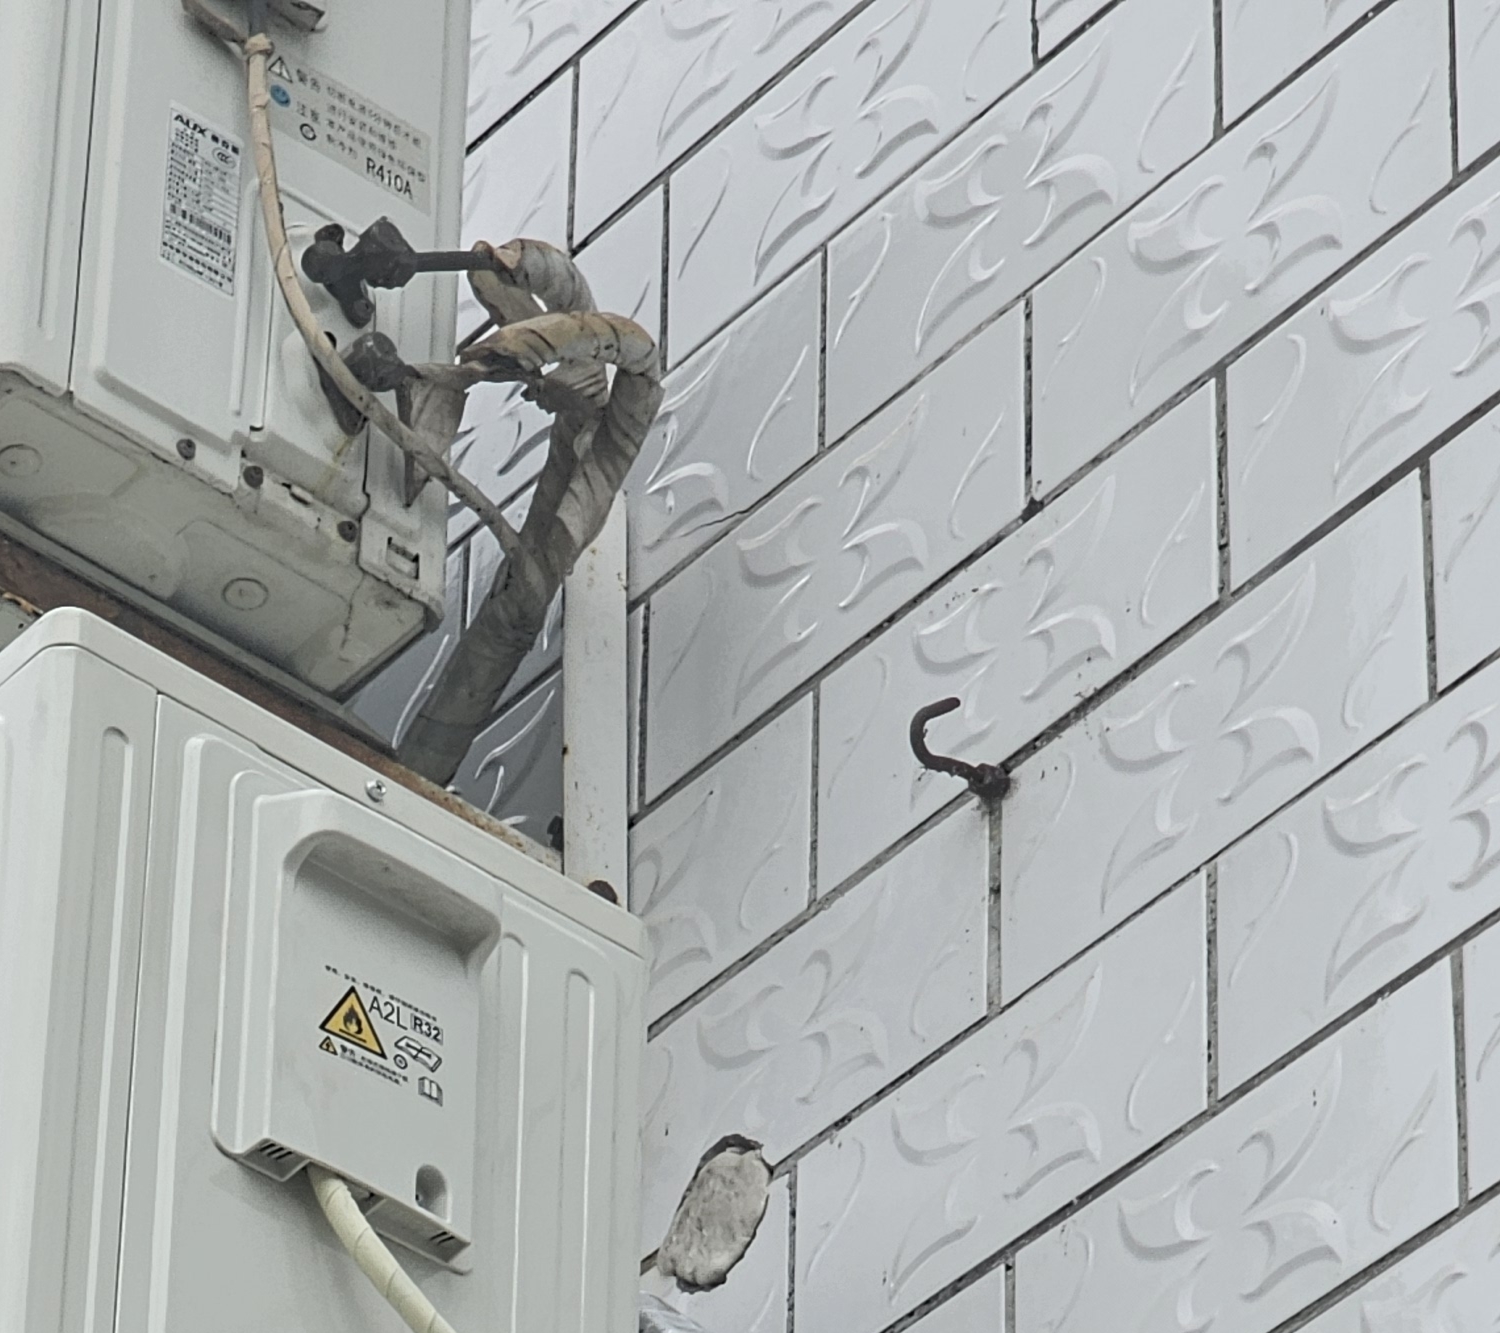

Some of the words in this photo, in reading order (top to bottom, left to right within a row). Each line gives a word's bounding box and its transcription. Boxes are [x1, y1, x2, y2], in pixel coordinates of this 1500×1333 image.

[173, 113, 209, 137] AUX
[366, 157, 414, 200] R410A
[368, 995, 409, 1031] A2L
[413, 1015, 442, 1043] R32
